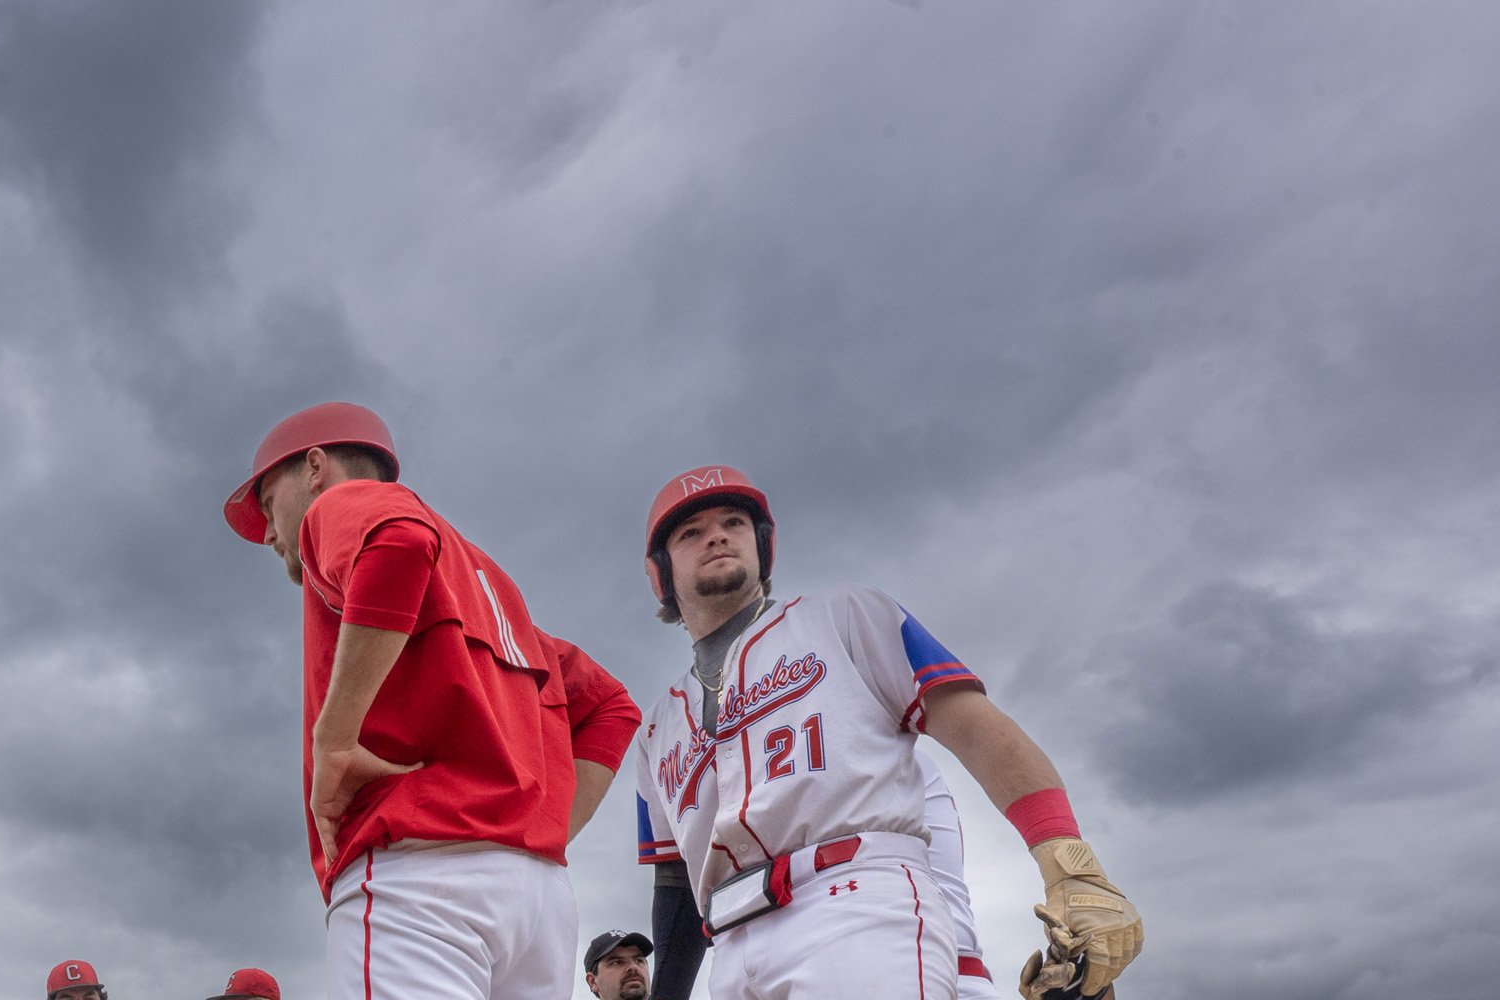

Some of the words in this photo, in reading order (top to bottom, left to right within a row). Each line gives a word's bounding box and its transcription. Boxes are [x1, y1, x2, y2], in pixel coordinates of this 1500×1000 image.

[680, 469, 724, 497] M
[764, 713, 826, 784] 21
[65, 964, 81, 981] C
